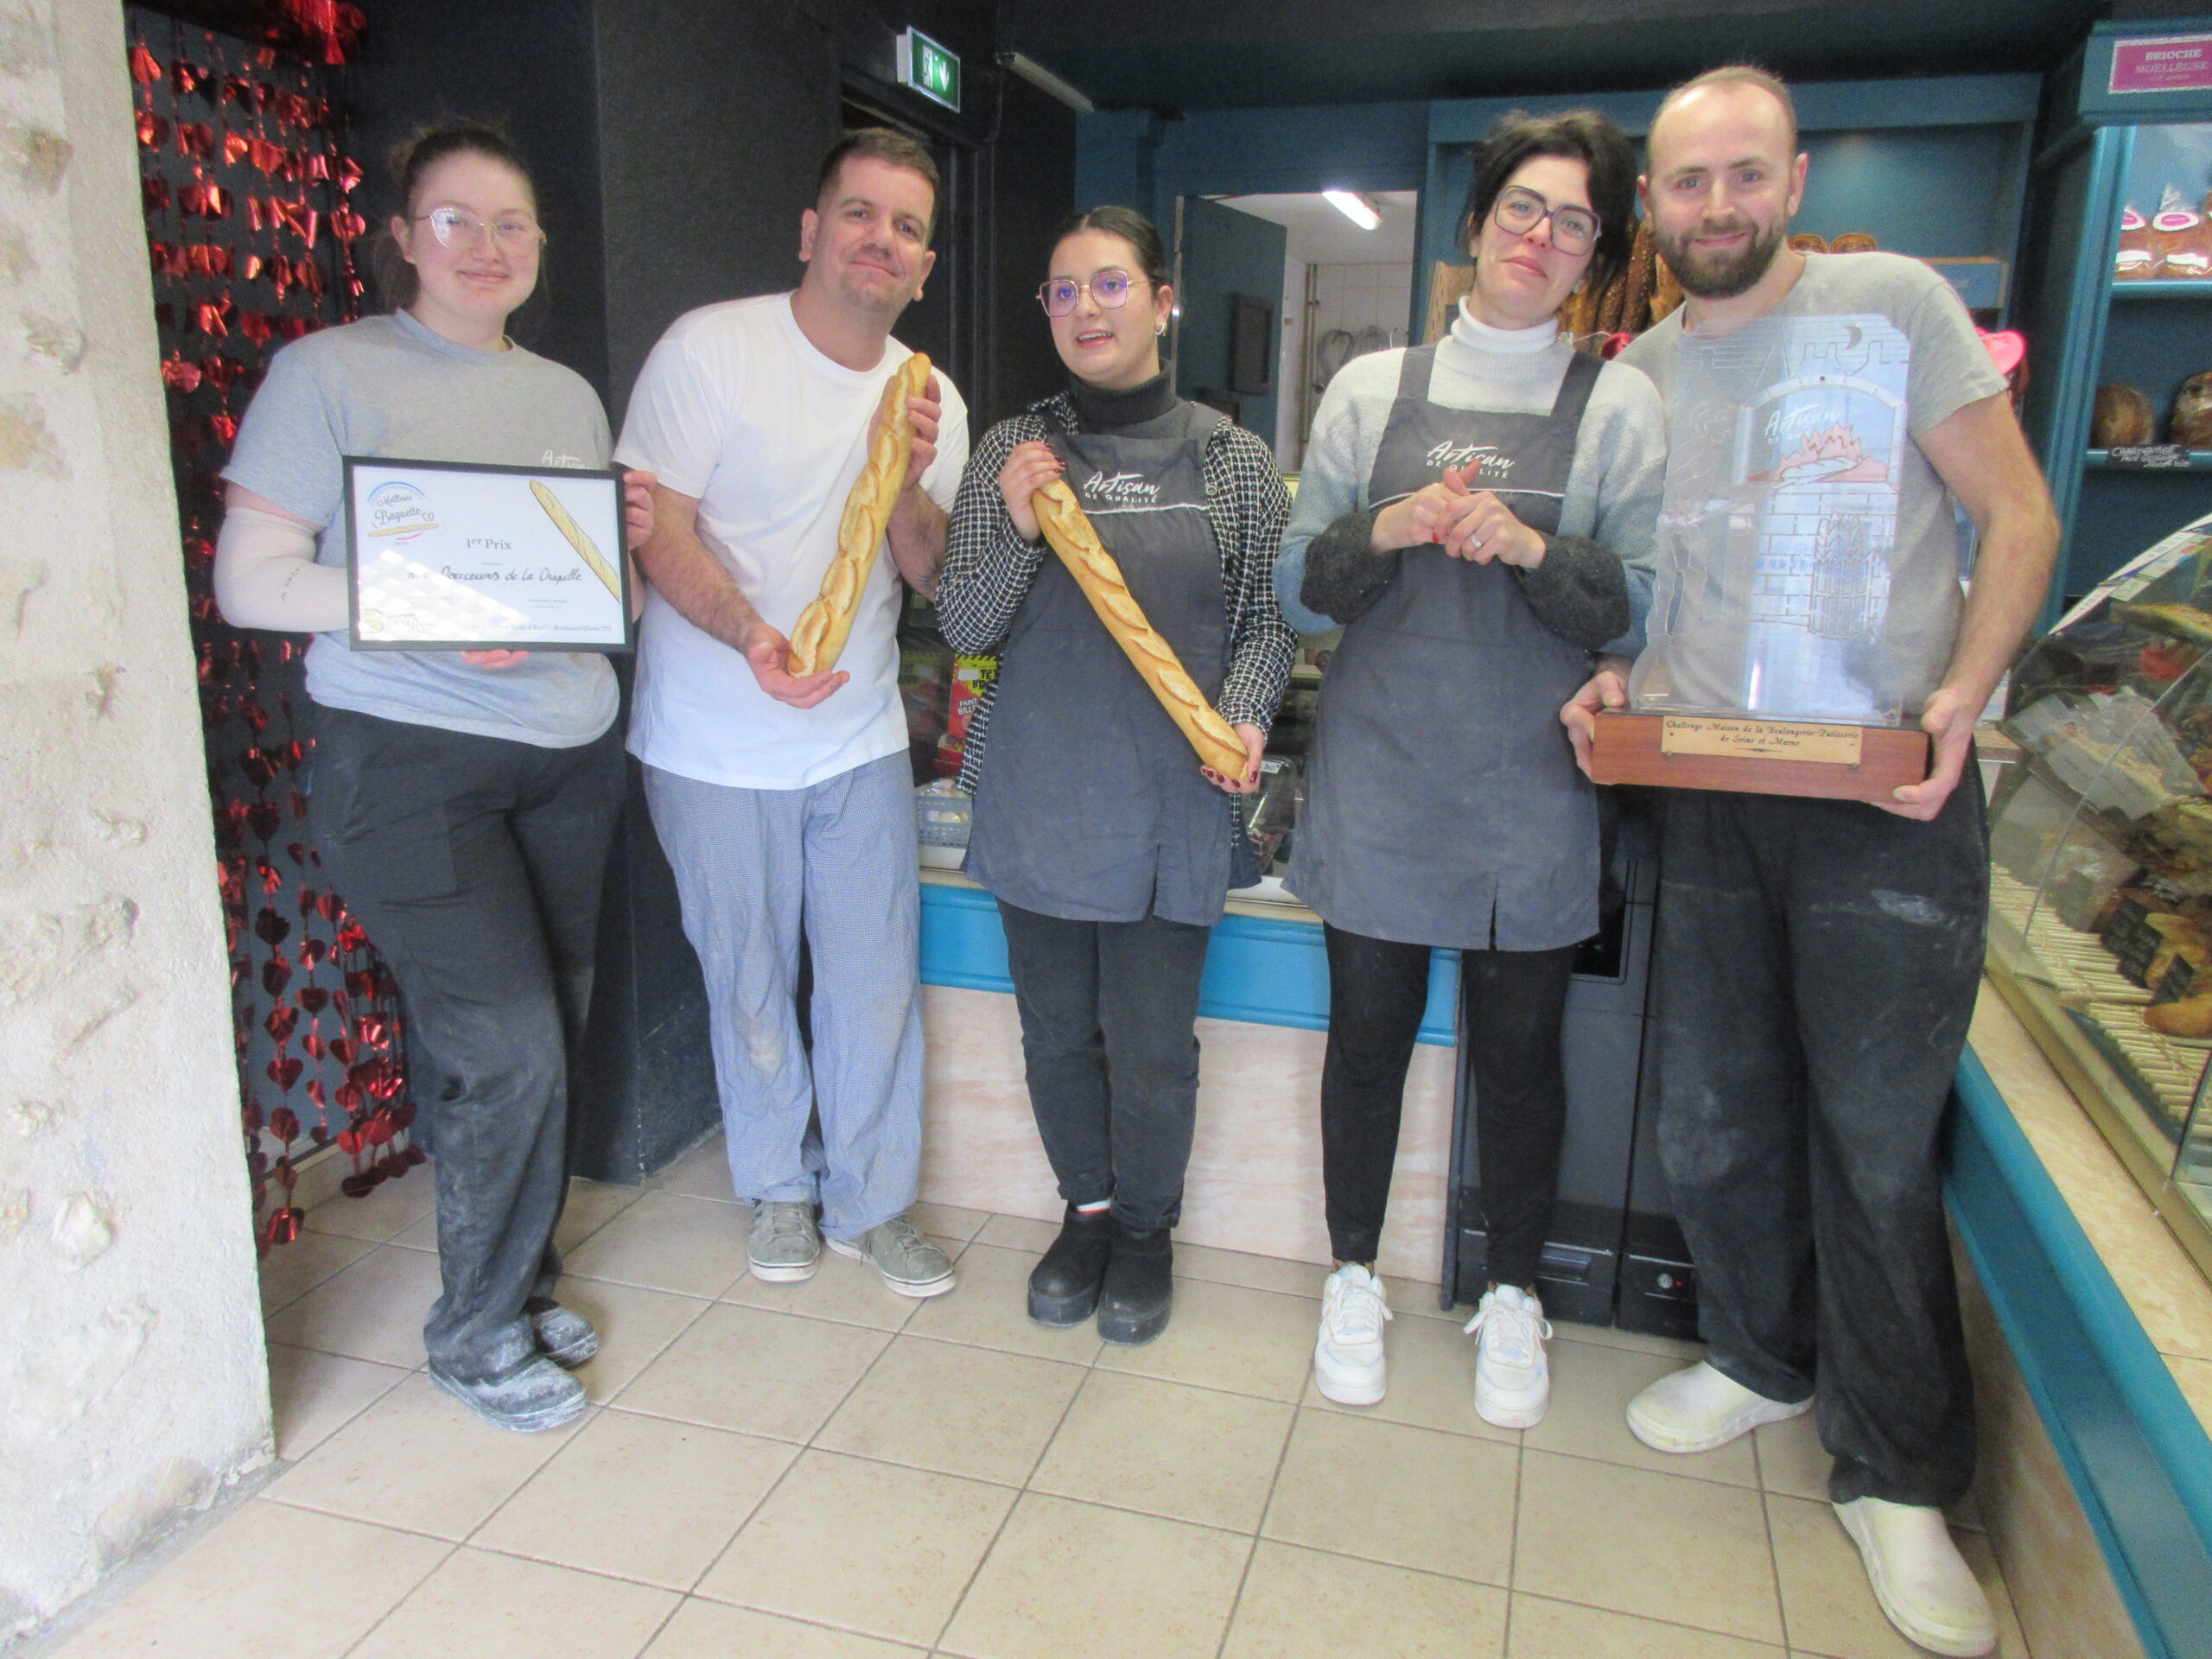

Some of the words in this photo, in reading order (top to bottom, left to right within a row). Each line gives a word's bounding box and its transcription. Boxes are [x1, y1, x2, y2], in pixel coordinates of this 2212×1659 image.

[2145, 49, 2202, 61] BRIOCHE
[1427, 441, 1516, 469] Artisan
[1451, 463, 1509, 478] QLITÉ
[1083, 471, 1160, 495] Artisan
[1105, 493, 1158, 504] QUALITÉ
[374, 505, 422, 525] Baguette
[486, 538, 512, 550] Prix
[505, 568, 518, 581] de
[1667, 720, 1703, 732] Challenge
[1707, 722, 1739, 732] Maison
[1732, 734, 1755, 743] Seine
[1769, 736, 1800, 746] Marne
